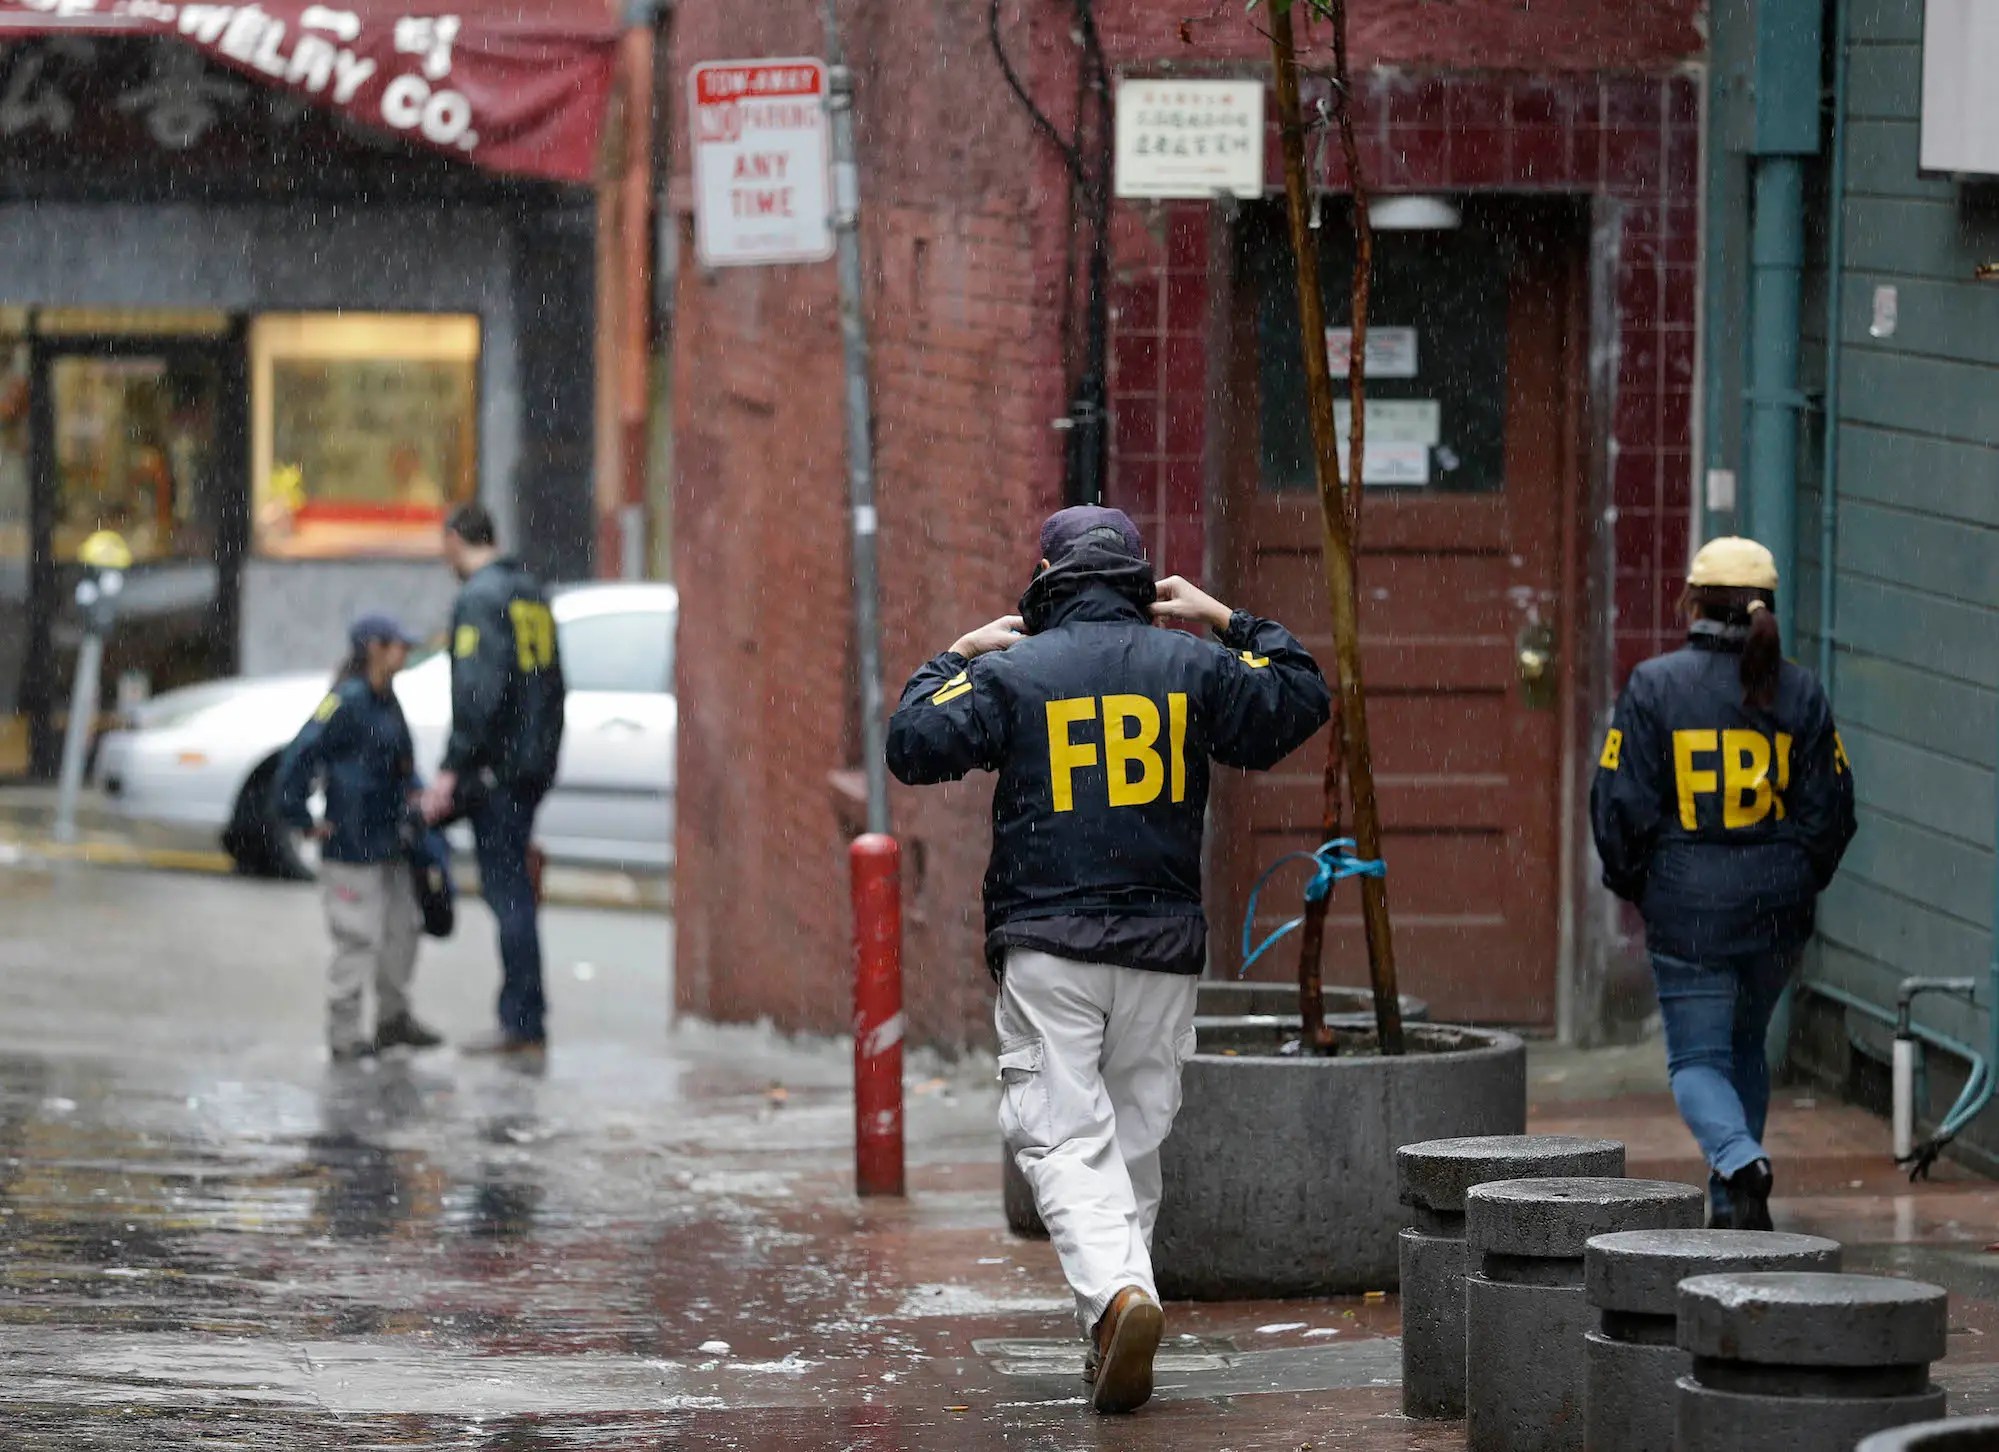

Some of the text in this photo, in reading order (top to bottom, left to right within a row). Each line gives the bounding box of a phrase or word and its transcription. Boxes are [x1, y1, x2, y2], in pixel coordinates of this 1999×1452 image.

[380, 73, 479, 151] CO.
[731, 187, 796, 218] TIME
[733, 152, 790, 178] ANY
[1046, 692, 1188, 812] FBI
[1672, 729, 1793, 831] FBI
